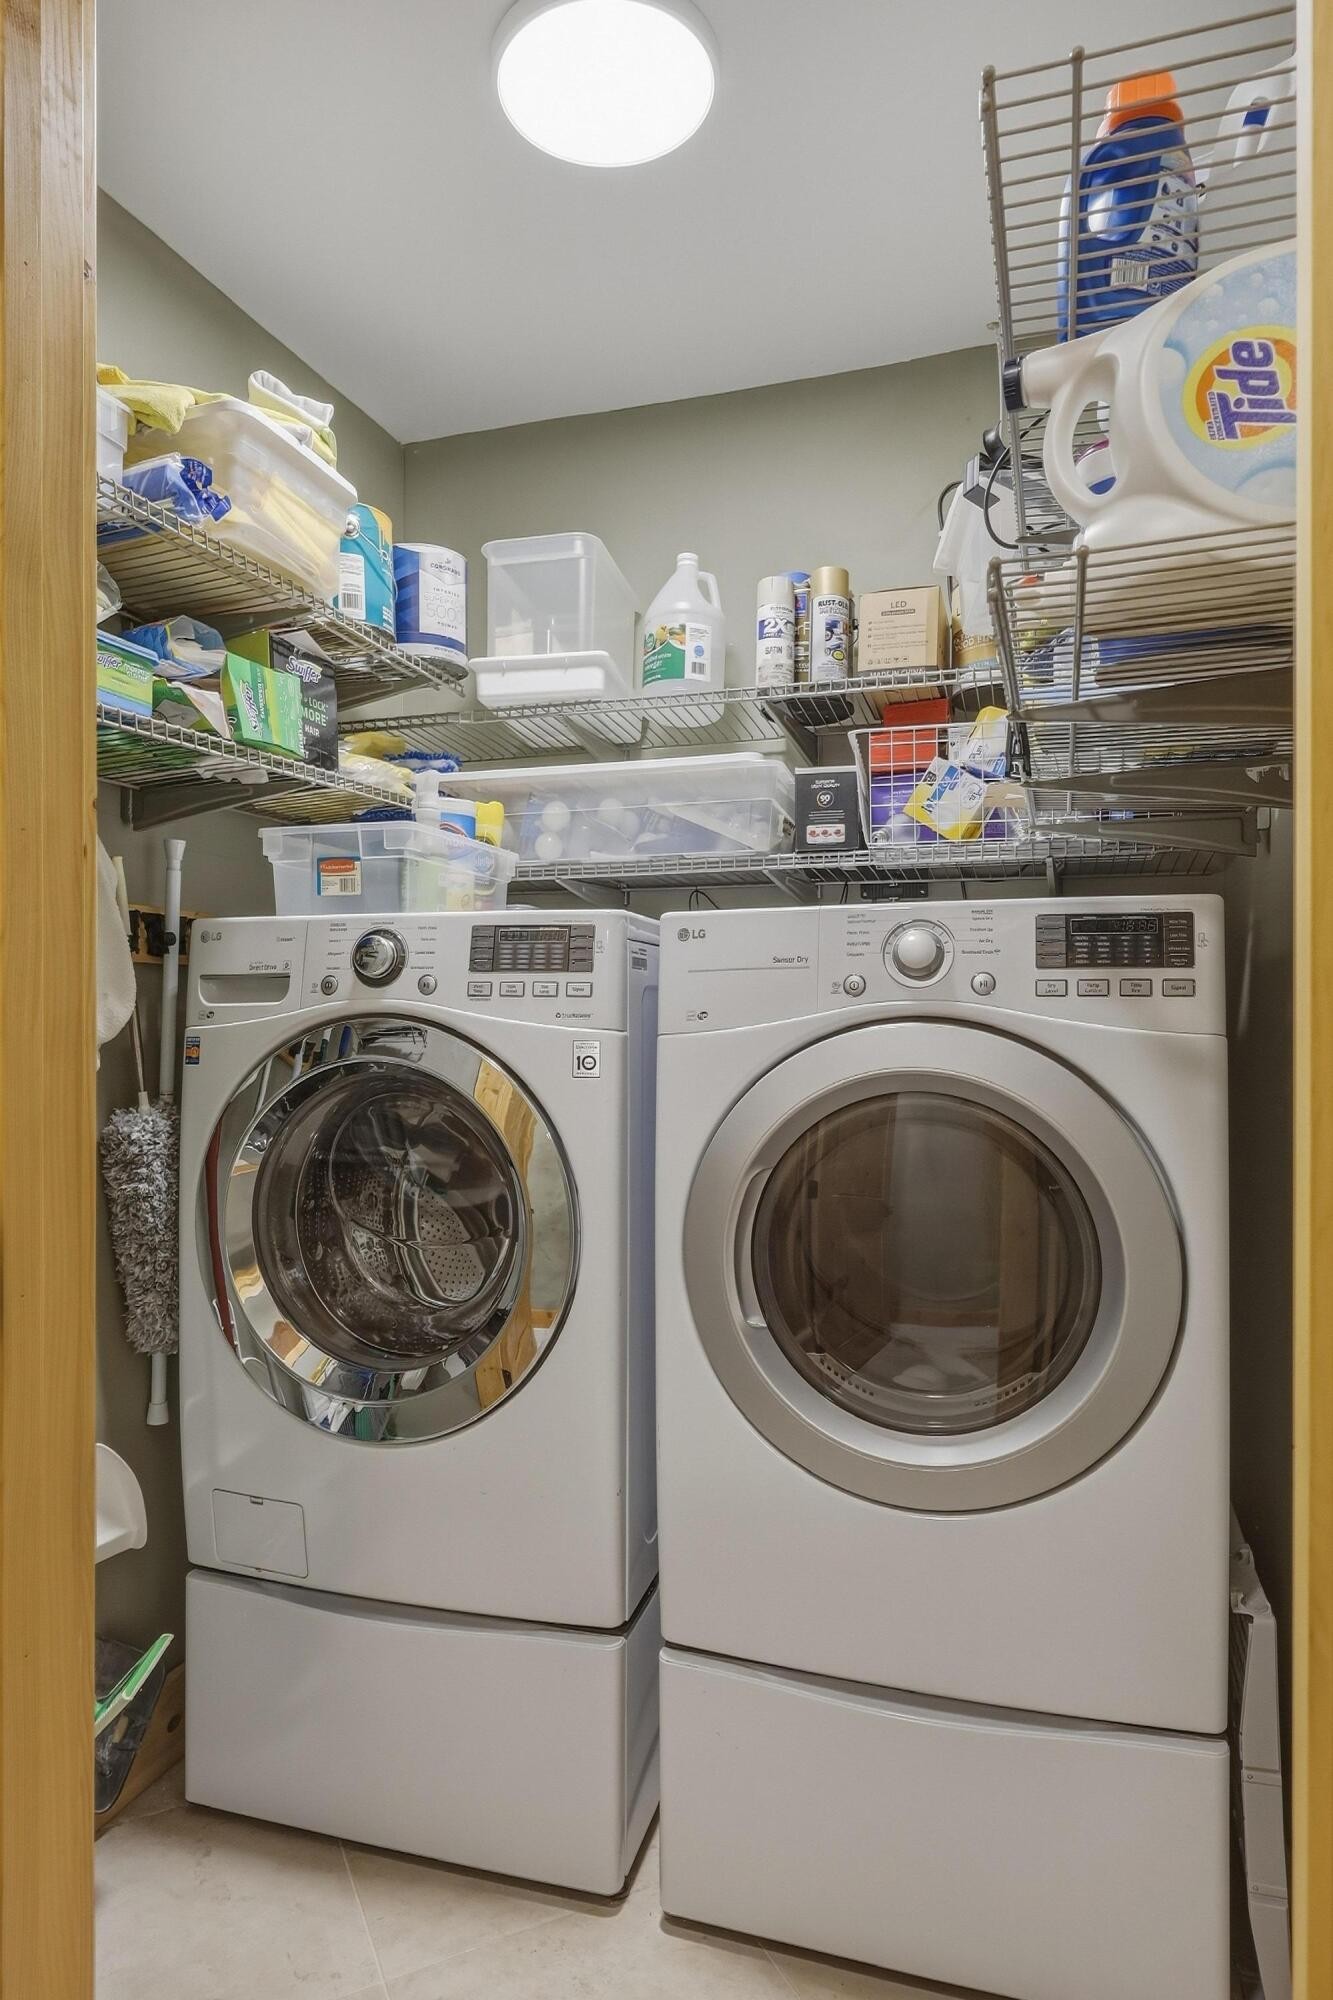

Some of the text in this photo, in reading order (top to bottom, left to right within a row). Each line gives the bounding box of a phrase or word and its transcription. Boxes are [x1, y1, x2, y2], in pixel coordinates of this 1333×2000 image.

[1216, 339, 1296, 440] Tide
[890, 600, 907, 609] LED
[764, 618, 787, 634] 2X
[764, 646, 783, 655] SATIN
[286, 656, 321, 683] Swiffer
[211, 932, 222, 942] LG
[692, 929, 706, 939] LG
[773, 955, 809, 965] Sensor Dry
[576, 1055, 597, 1071] 10
